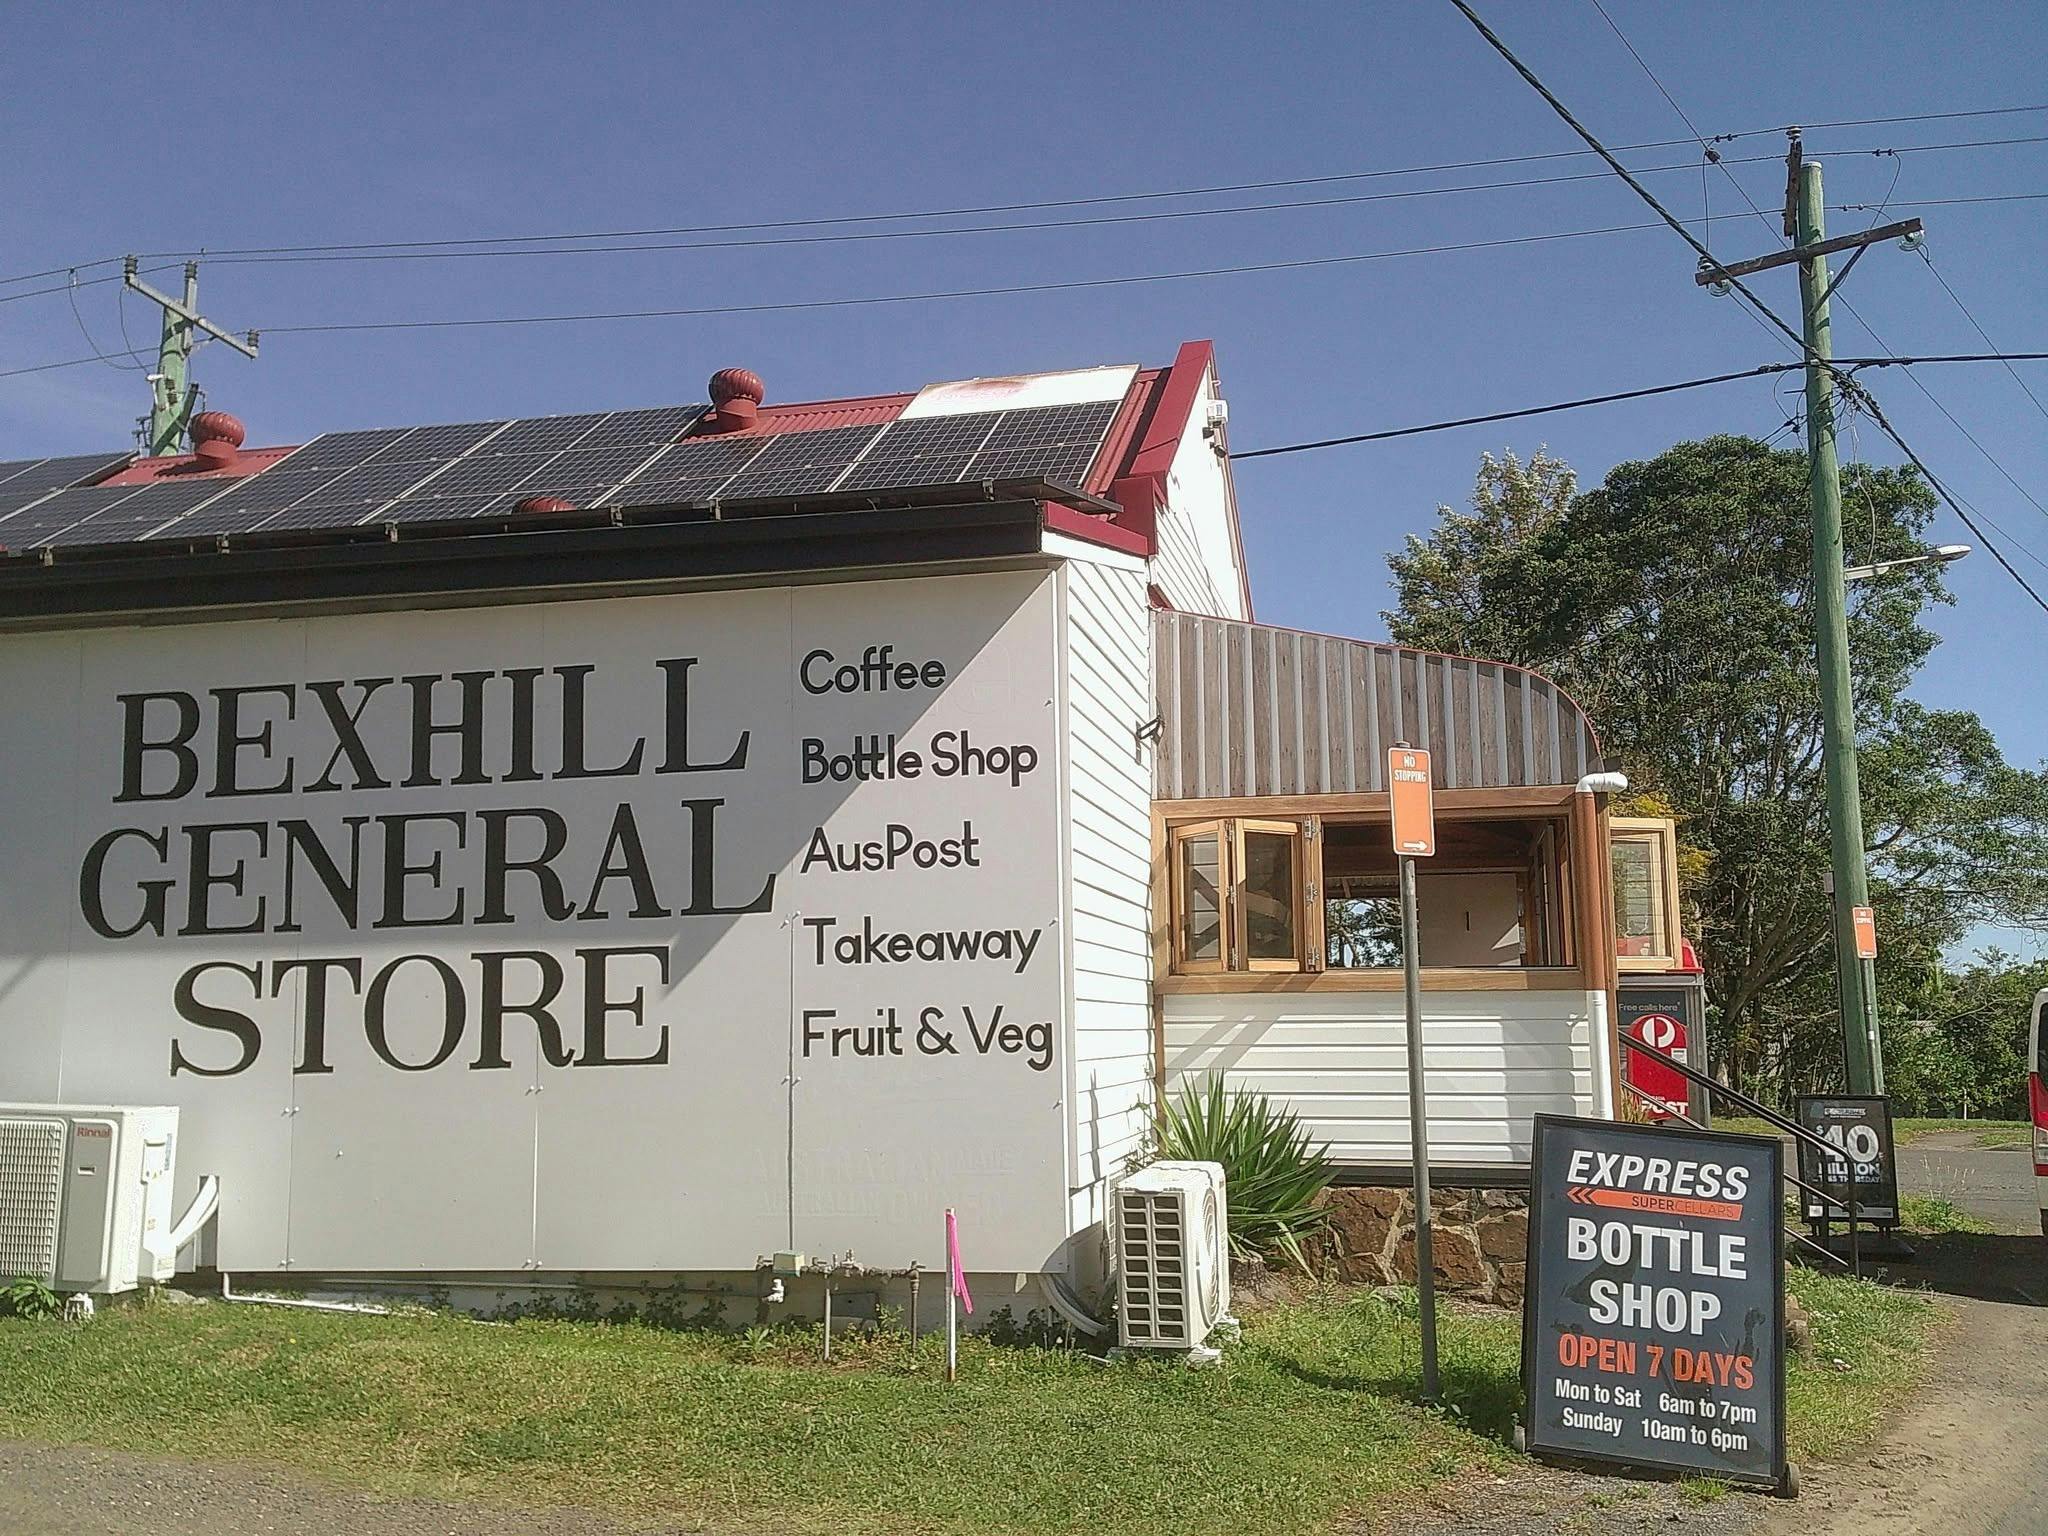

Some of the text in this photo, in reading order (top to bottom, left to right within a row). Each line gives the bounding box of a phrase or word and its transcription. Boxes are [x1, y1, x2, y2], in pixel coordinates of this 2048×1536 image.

[800, 645, 947, 694] Coffee
[112, 657, 751, 803] BEXHILL
[802, 730, 1038, 787] Bottle Shop
[1394, 769, 1427, 782] STOPPING
[1403, 755, 1415, 767] NO
[79, 798, 777, 940] GENERAL
[800, 821, 980, 874] AusPost
[803, 916, 1042, 974] Takeaway
[170, 946, 671, 1078] STORE
[1618, 1003, 1637, 1011] Free
[803, 1005, 1053, 1071] Fruit & Veg
[1566, 1149, 1749, 1201] EXPRESS
[1567, 1217, 1747, 1280] BOTTLE
[1589, 1280, 1721, 1335] SHOP
[1559, 1333, 1754, 1390] OPEN 7 DAYS
[1555, 1378, 1757, 1425] Mon to Sat 6am to 7pm
[1563, 1407, 1749, 1451] Sunday 10am to 6pm
